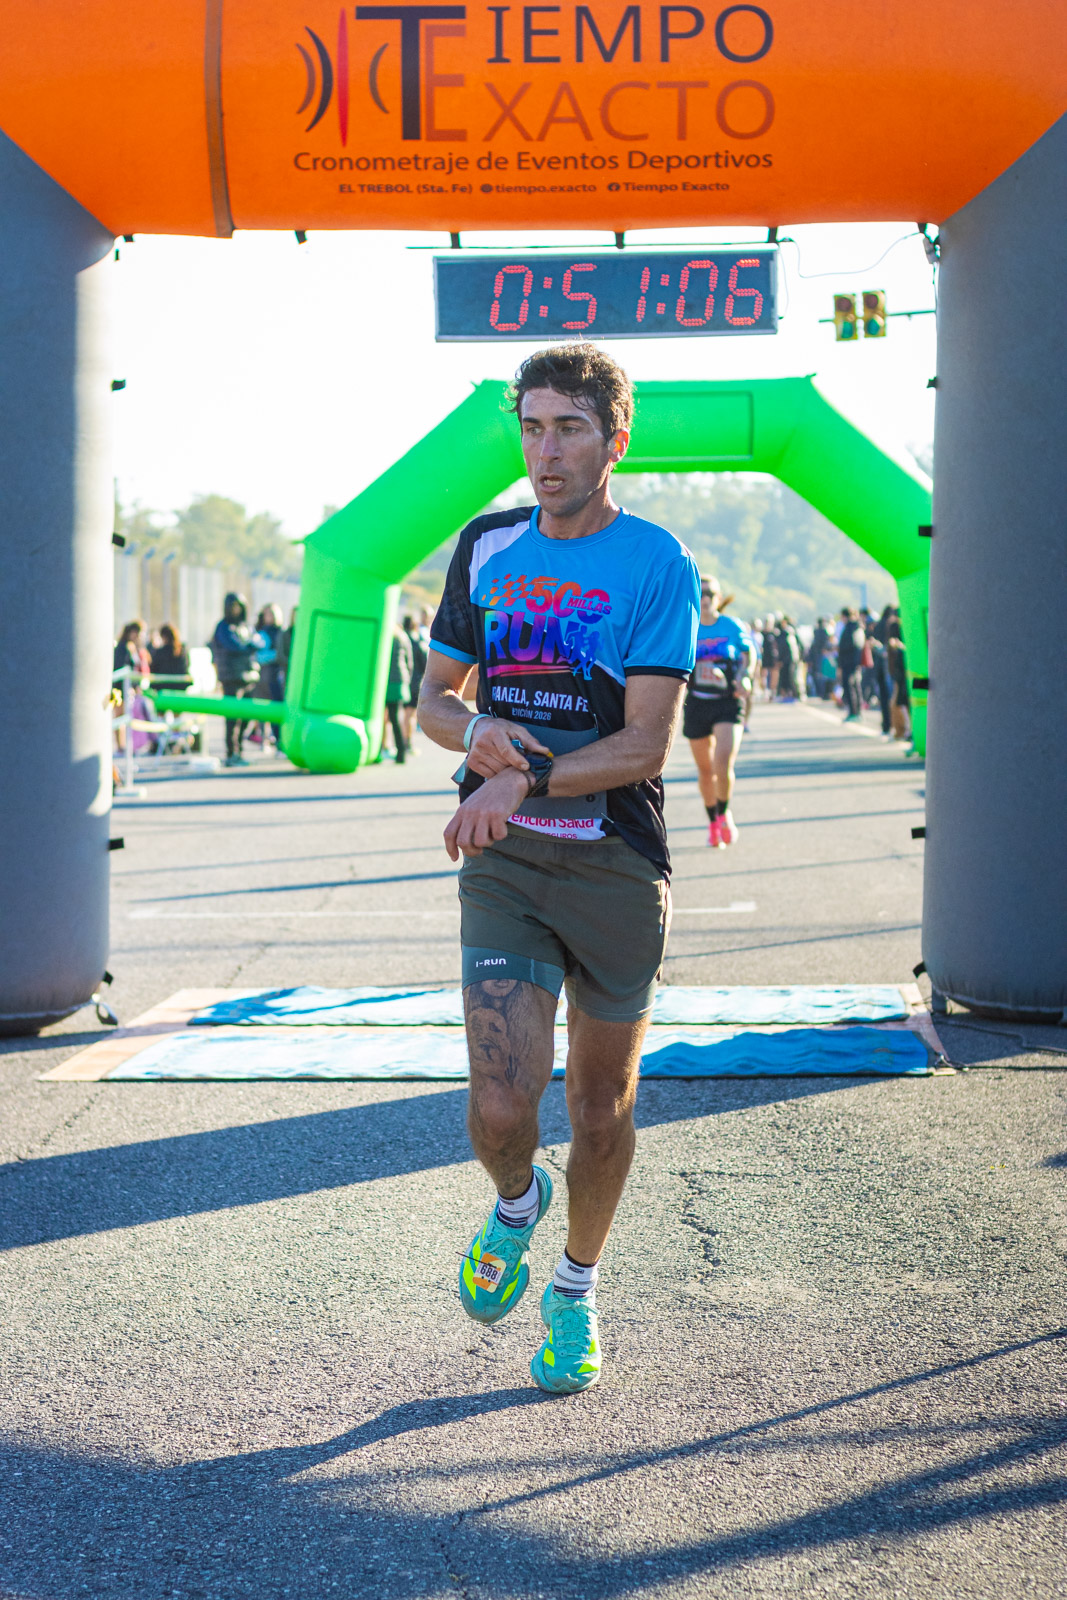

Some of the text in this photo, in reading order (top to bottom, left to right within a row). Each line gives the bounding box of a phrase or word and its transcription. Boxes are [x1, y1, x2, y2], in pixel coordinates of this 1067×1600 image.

[293, 149, 774, 175] Cronometraje de Eventos Deportivos
[338, 183, 355, 194] EL
[357, 183, 414, 194] TREBOL
[416, 182, 449, 195] (Sta.
[451, 182, 473, 195] Fe)
[622, 181, 679, 194] Tiempo
[681, 180, 731, 193] Exacto
[566, 596, 613, 616] MILLAS
[484, 609, 581, 665] RUN
[533, 690, 573, 711] SANTA
[574, 695, 589, 713] FE
[533, 710, 552, 721] 2026
[480, 1263, 499, 1281] 688
